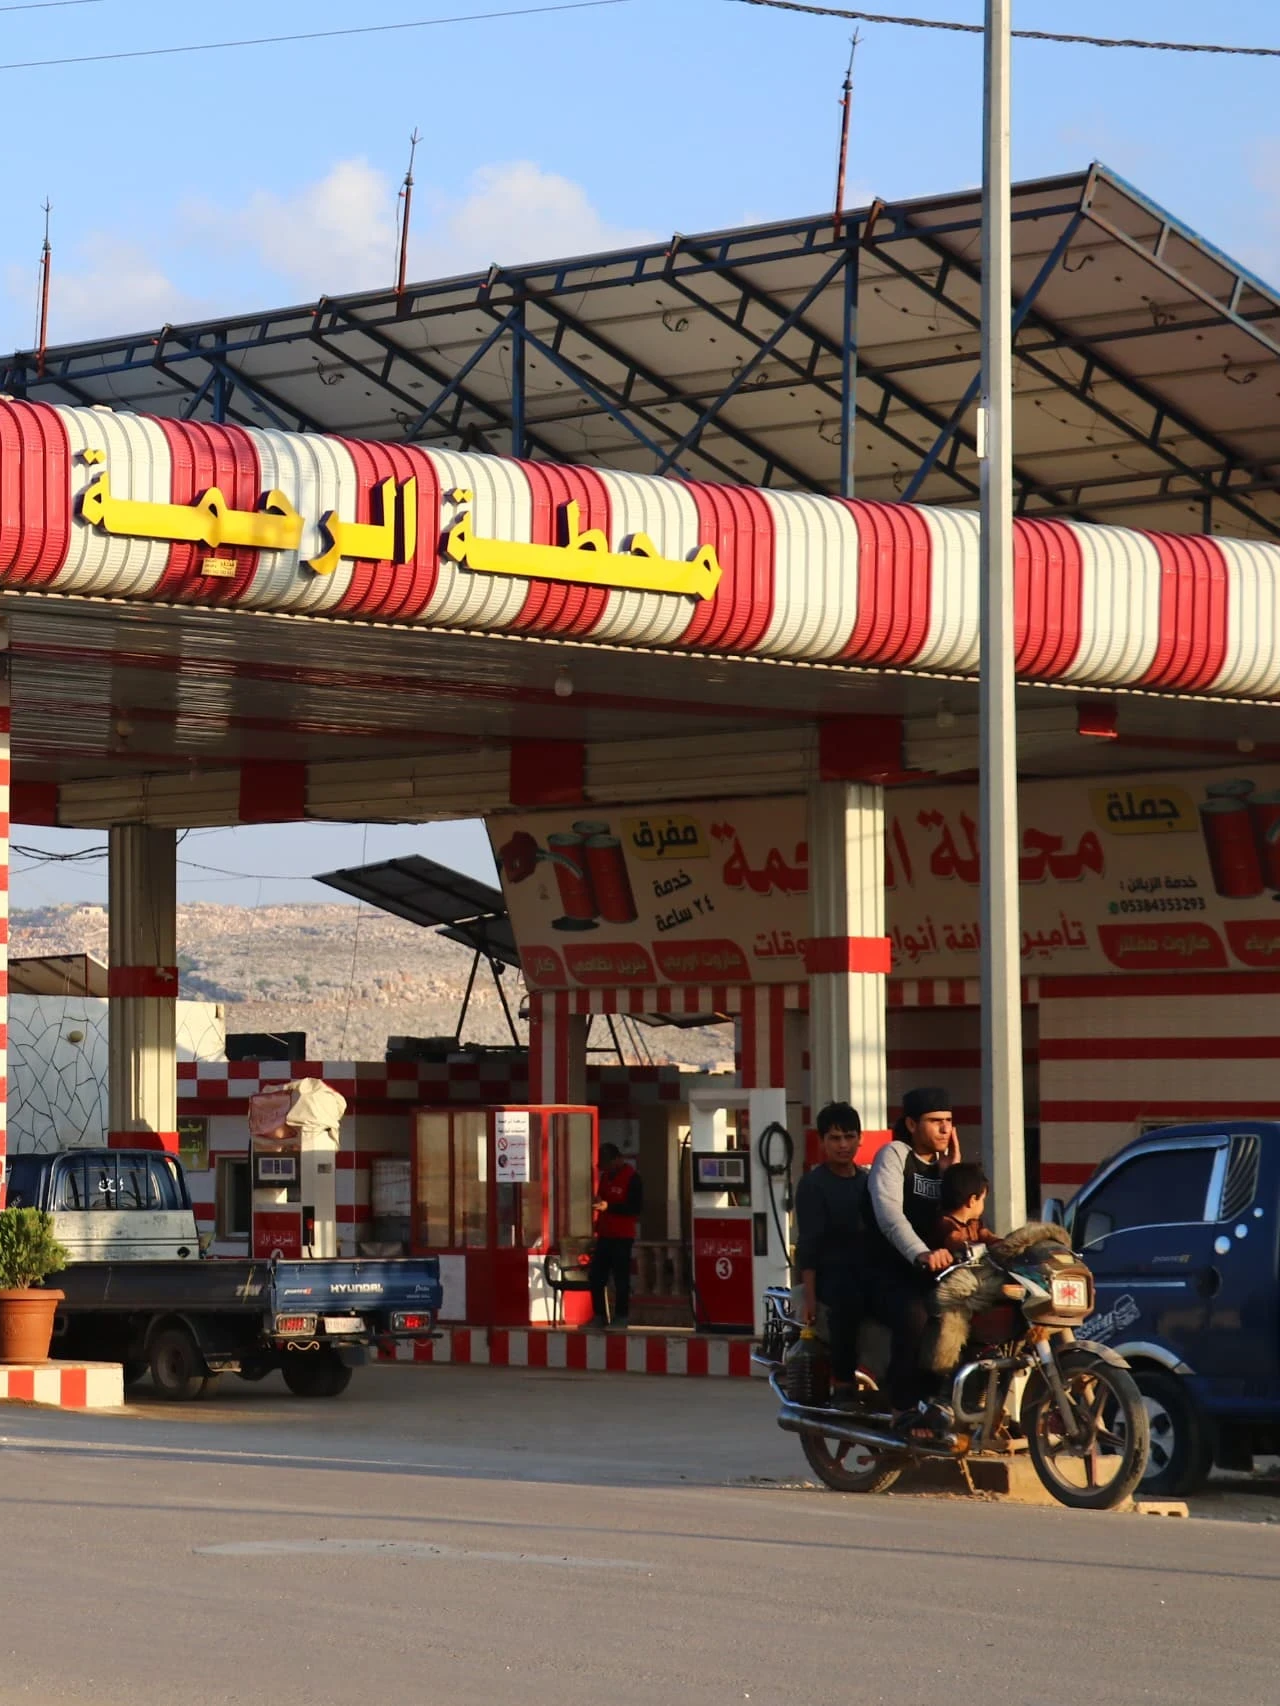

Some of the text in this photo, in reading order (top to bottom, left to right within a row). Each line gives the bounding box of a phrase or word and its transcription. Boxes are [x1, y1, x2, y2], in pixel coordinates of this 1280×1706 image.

[74, 448, 722, 600] محطة الرحمة
[632, 820, 698, 856] مفرق
[653, 868, 693, 898] خدمة
[719, 1260, 729, 1277] 3
[330, 1283, 384, 1294] HYUNDAI
